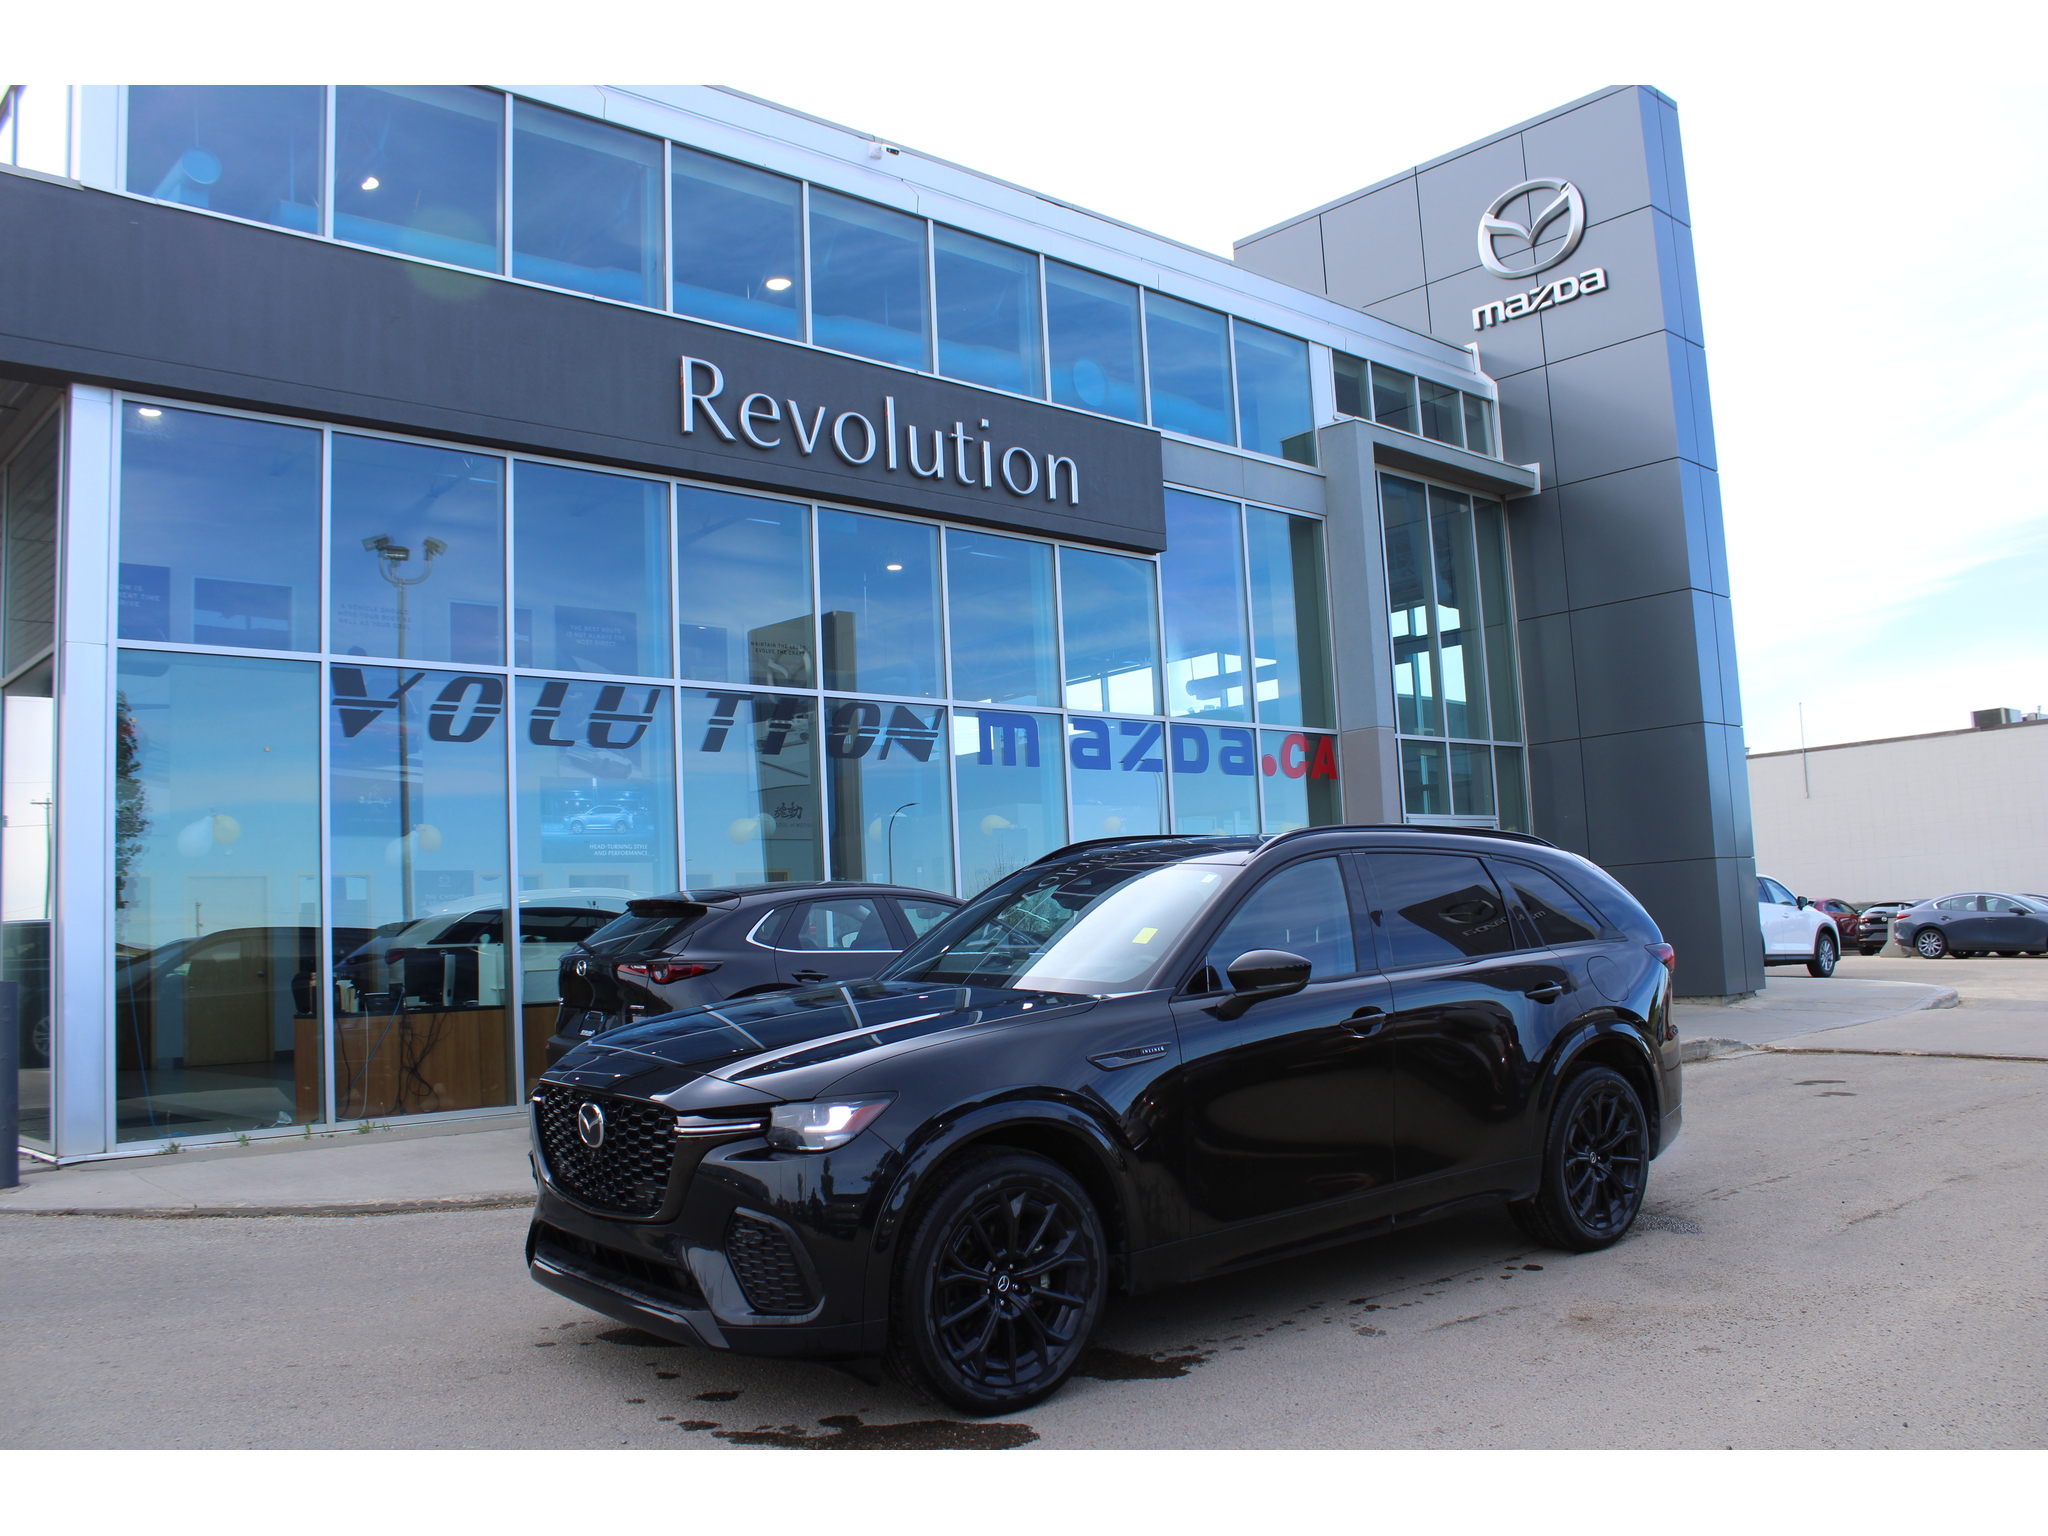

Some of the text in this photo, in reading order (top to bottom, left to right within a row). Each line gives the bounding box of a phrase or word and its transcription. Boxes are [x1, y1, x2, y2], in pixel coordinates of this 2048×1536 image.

[1472, 267, 1608, 331] mazda
[680, 355, 1080, 506] Revolution
[347, 603, 379, 613] VEHICLE
